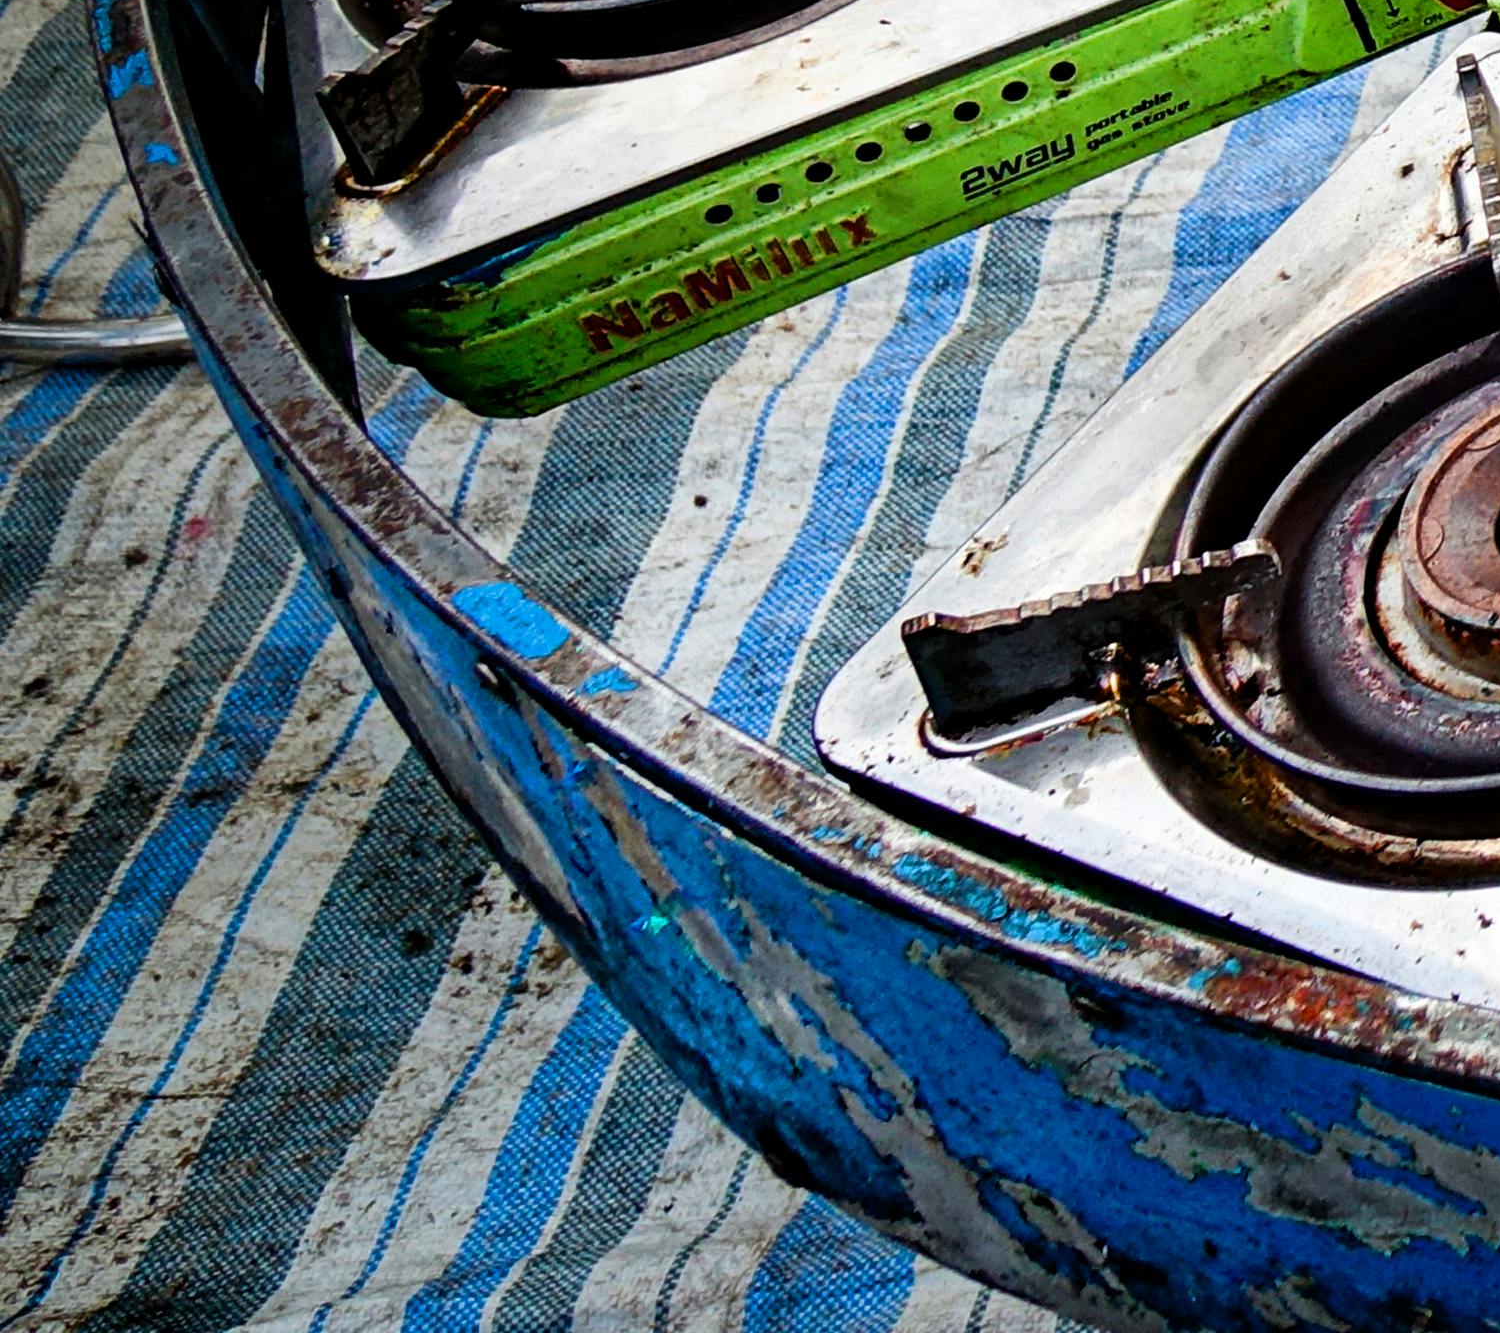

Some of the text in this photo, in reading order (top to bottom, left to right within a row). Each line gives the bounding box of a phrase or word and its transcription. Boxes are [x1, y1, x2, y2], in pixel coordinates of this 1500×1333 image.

[1422, 12, 1444, 27] ON
[960, 90, 1174, 199] 2way portable
[1086, 97, 1192, 154] gas stove
[579, 210, 877, 355] NaMilux
